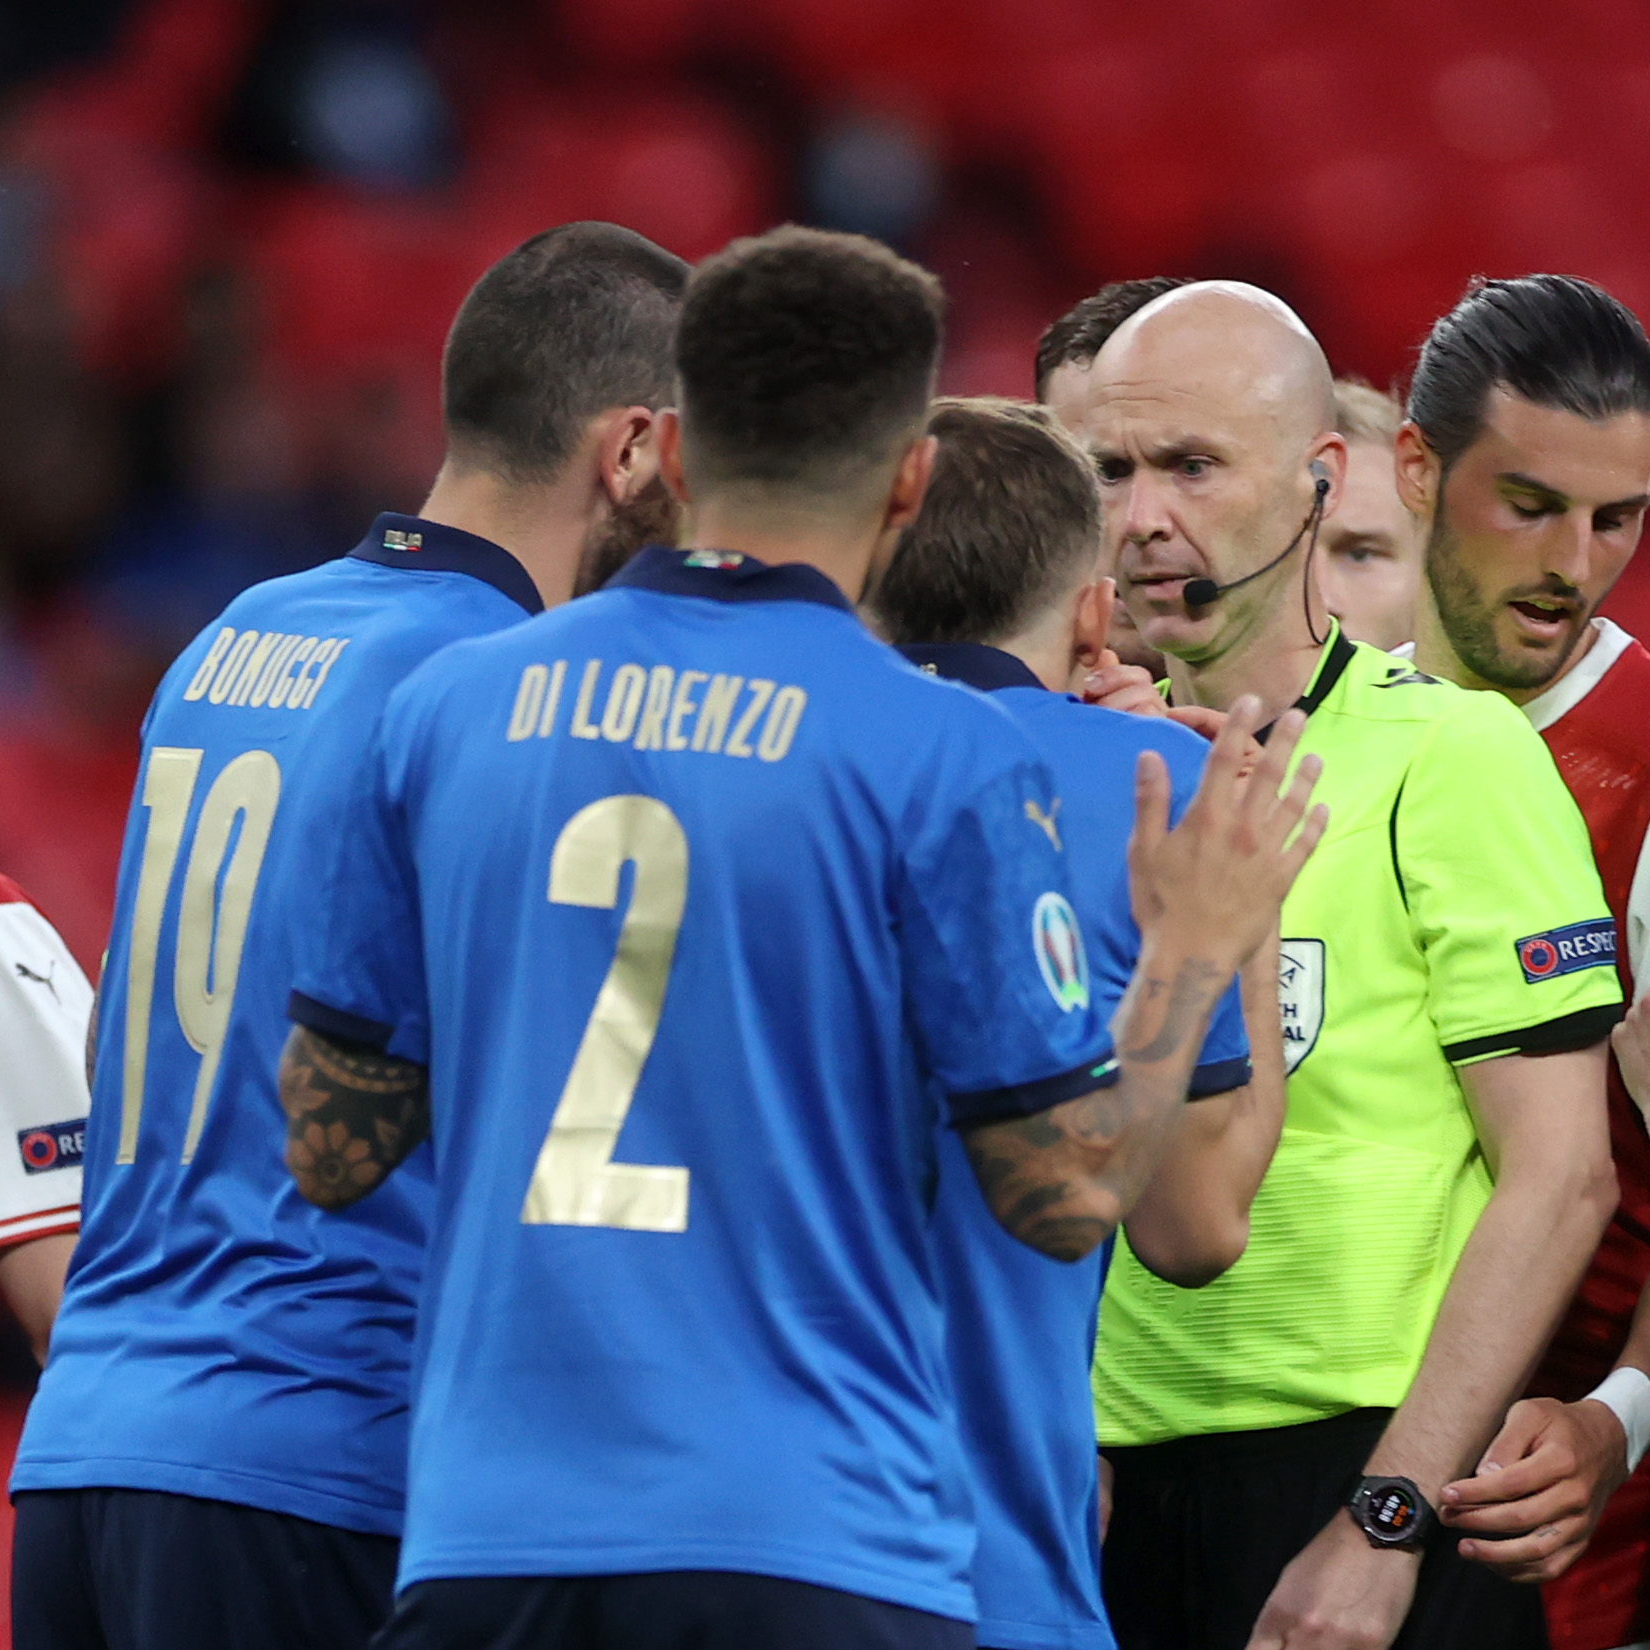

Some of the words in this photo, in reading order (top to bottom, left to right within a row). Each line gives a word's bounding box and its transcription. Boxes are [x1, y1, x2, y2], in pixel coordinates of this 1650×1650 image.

[183, 627, 350, 709] BONUCCI
[506, 659, 568, 742] DI
[570, 658, 808, 763] LORENZO
[115, 746, 281, 1165] 19
[522, 794, 689, 1232] 2
